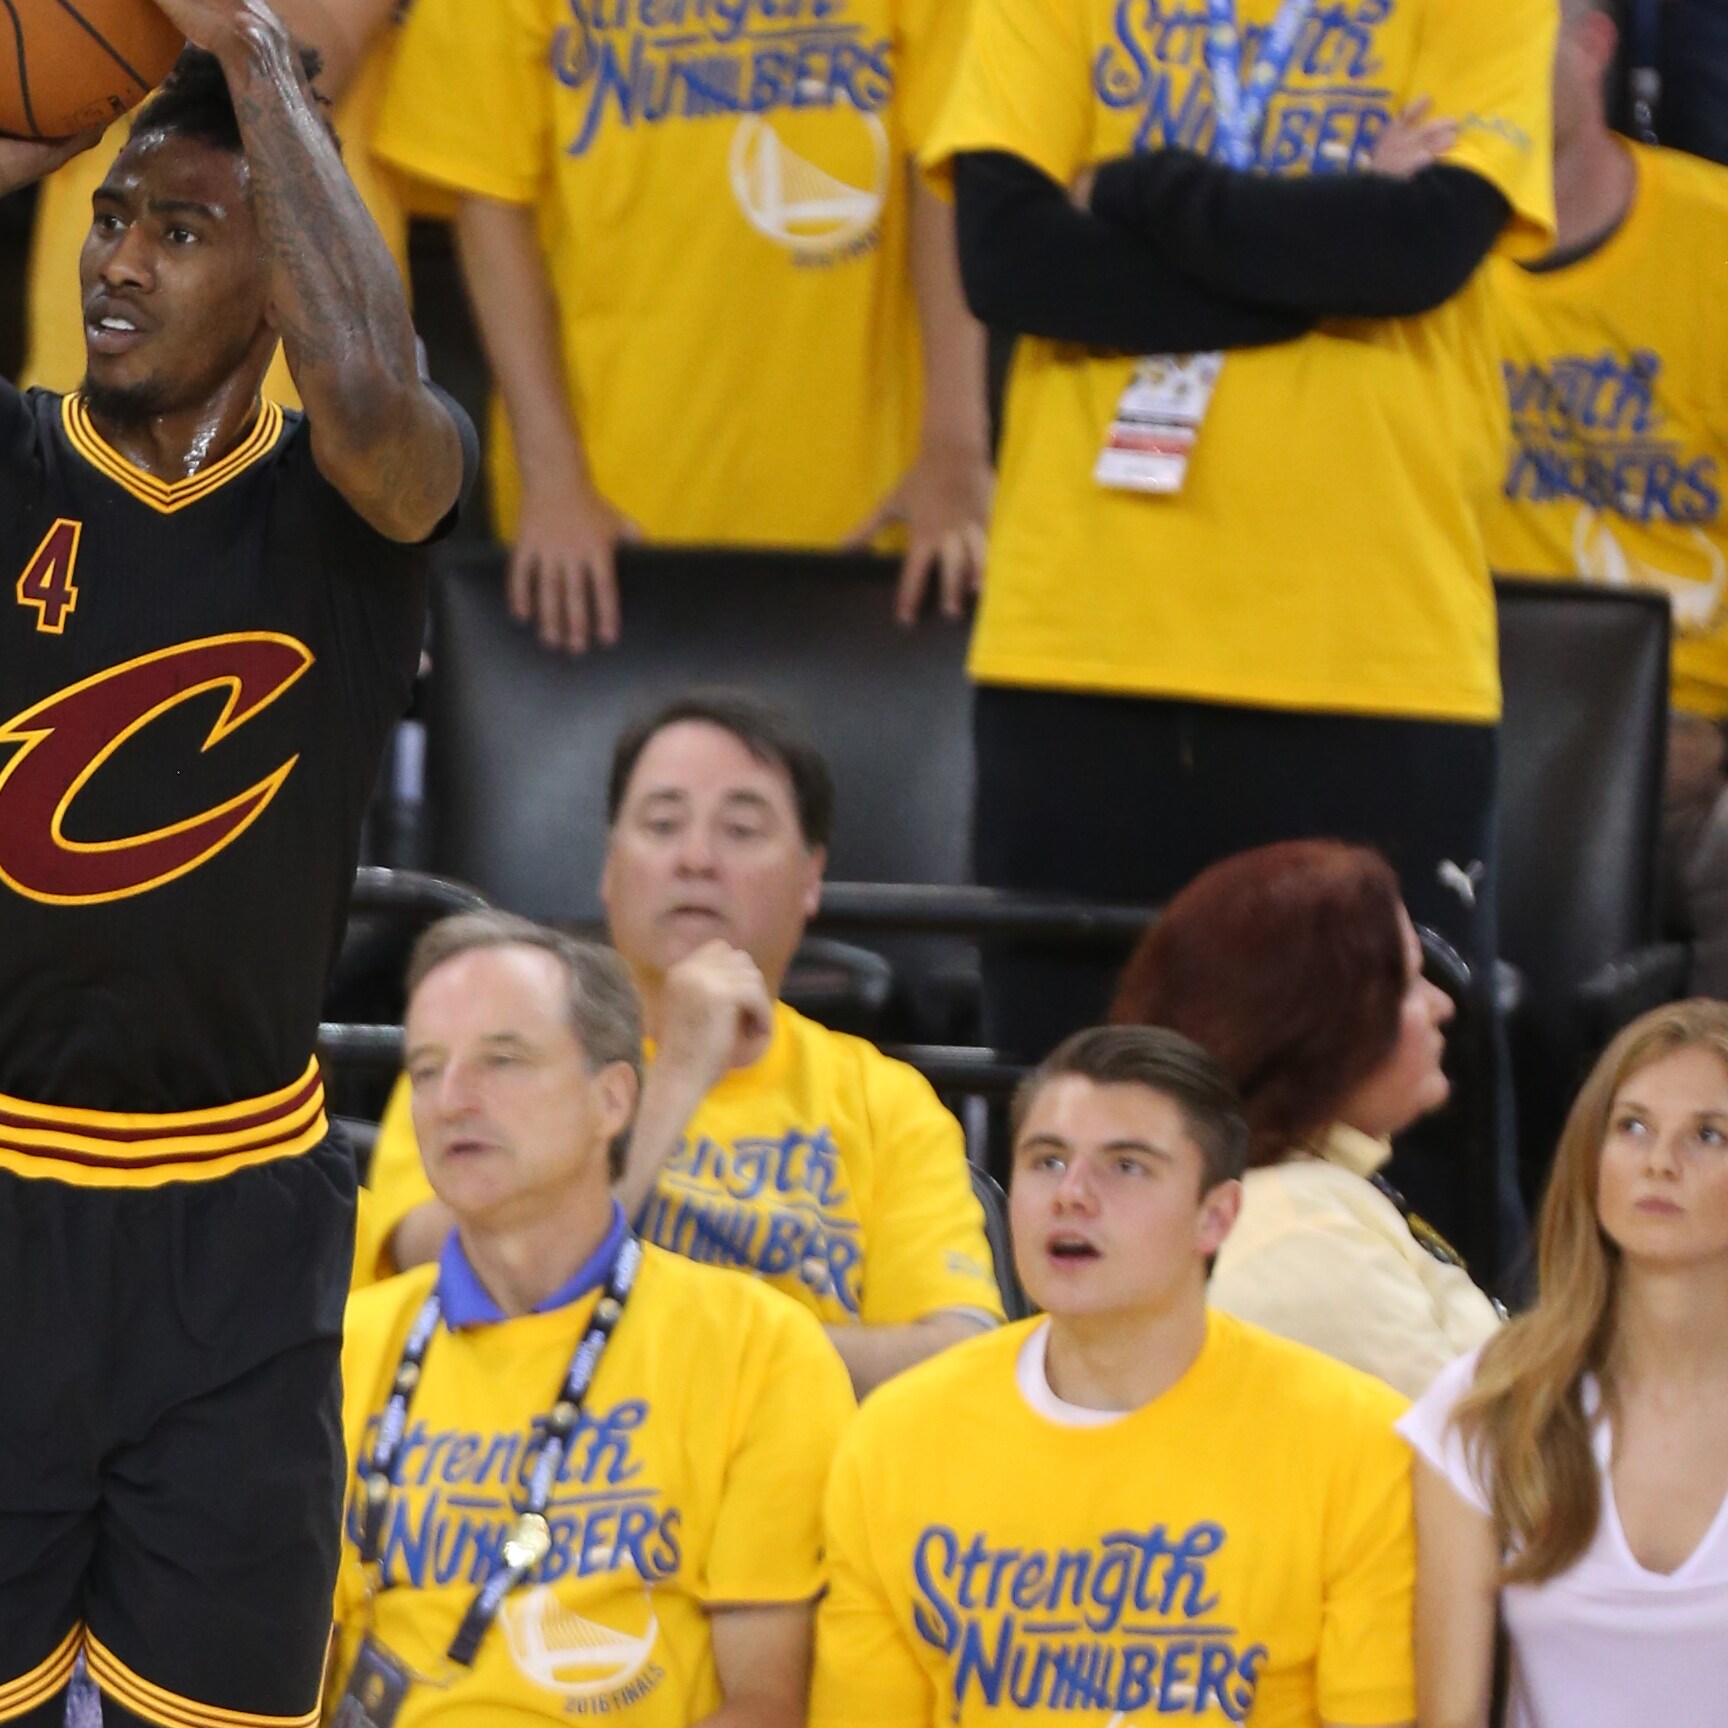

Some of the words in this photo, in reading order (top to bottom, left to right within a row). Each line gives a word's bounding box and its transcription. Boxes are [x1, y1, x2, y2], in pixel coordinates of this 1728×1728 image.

[567, 30, 894, 157] NUMBERS
[17, 518, 82, 634] 4
[913, 1520, 1227, 1657] Strength
[950, 1614, 1269, 1722] NUMBERS
